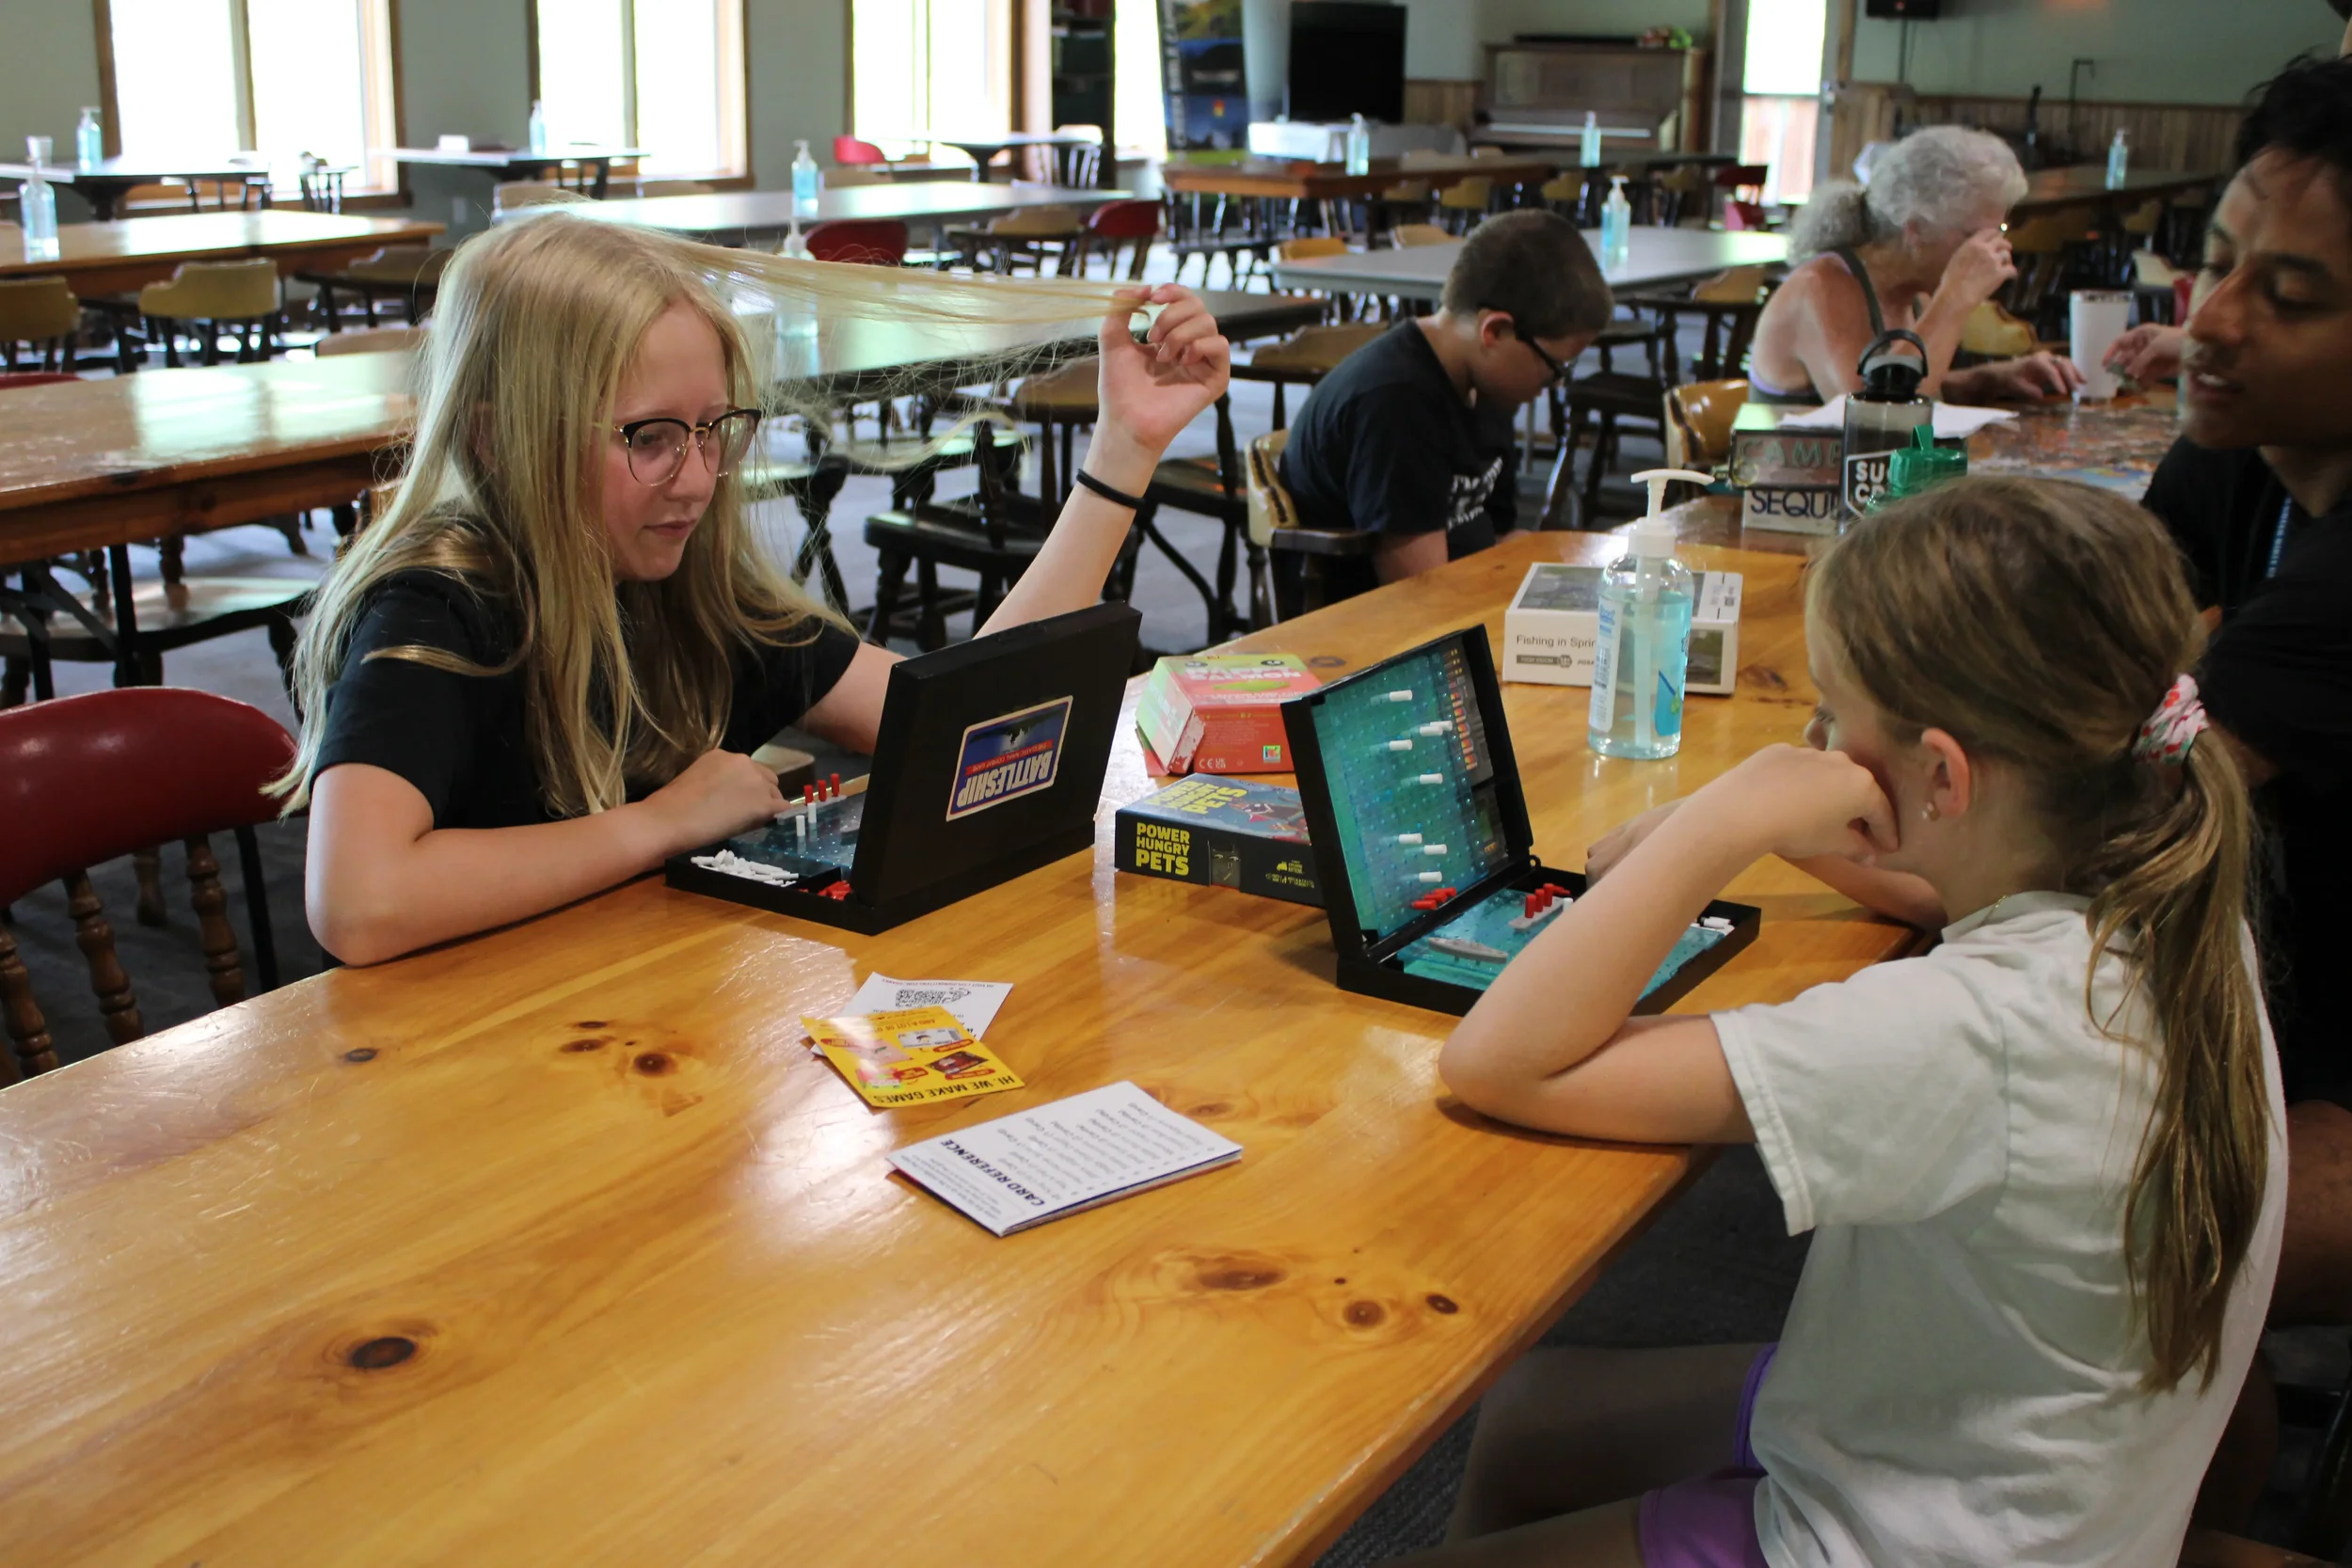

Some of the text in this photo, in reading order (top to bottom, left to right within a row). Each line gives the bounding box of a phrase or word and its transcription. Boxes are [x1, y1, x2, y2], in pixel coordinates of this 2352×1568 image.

[1855, 461, 1889, 483] SU
[1517, 635, 1554, 648] Fishing
[1557, 637, 1566, 646] in
[957, 750, 1053, 808] BATTLESHIP
[1181, 786, 1248, 815] PETS
[1136, 822, 1190, 844] POWER
[1136, 838, 1190, 856] HUNGRY
[1136, 849, 1189, 877] PETS
[927, 1083, 970, 1098] MAKE
[972, 1079, 993, 1090] WE
[939, 1139, 1009, 1187] REFERENCE
[1007, 1181, 1044, 1206] CARD
